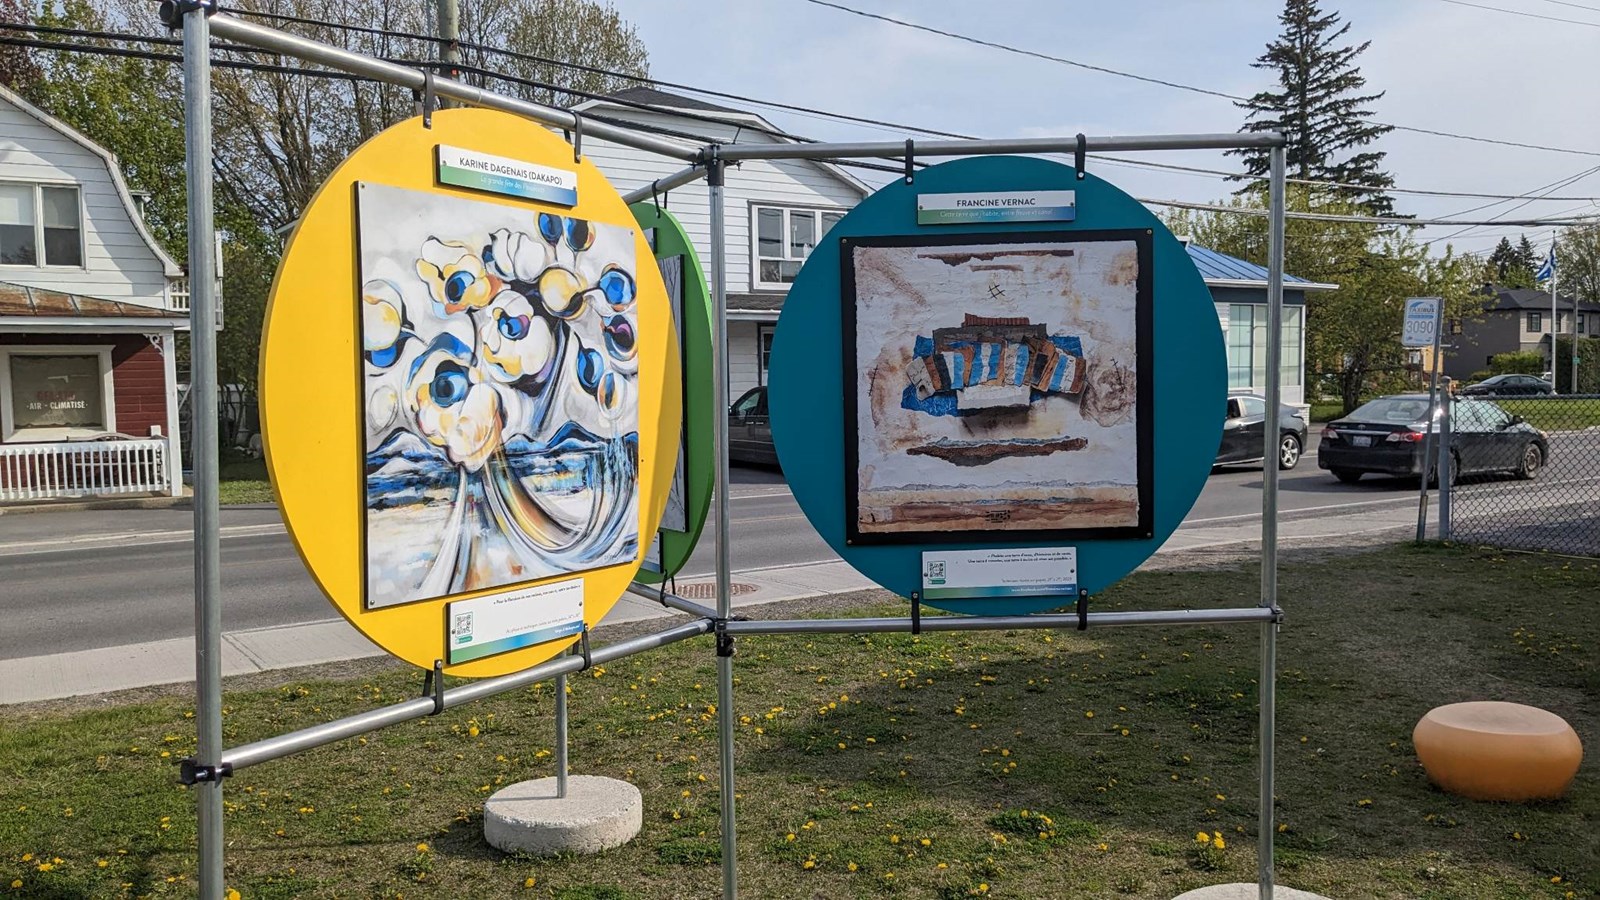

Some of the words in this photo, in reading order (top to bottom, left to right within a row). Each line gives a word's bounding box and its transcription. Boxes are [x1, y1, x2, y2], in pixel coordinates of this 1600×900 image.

[459, 157, 489, 171] KARINE
[490, 163, 528, 179] DAGENAIS
[529, 171, 563, 186] (DAKAPO)
[956, 199, 1000, 207] FRANCINE
[1001, 197, 1036, 206] VERNAC
[1406, 320, 1434, 334] 3090
[29, 402, 42, 410] AIR
